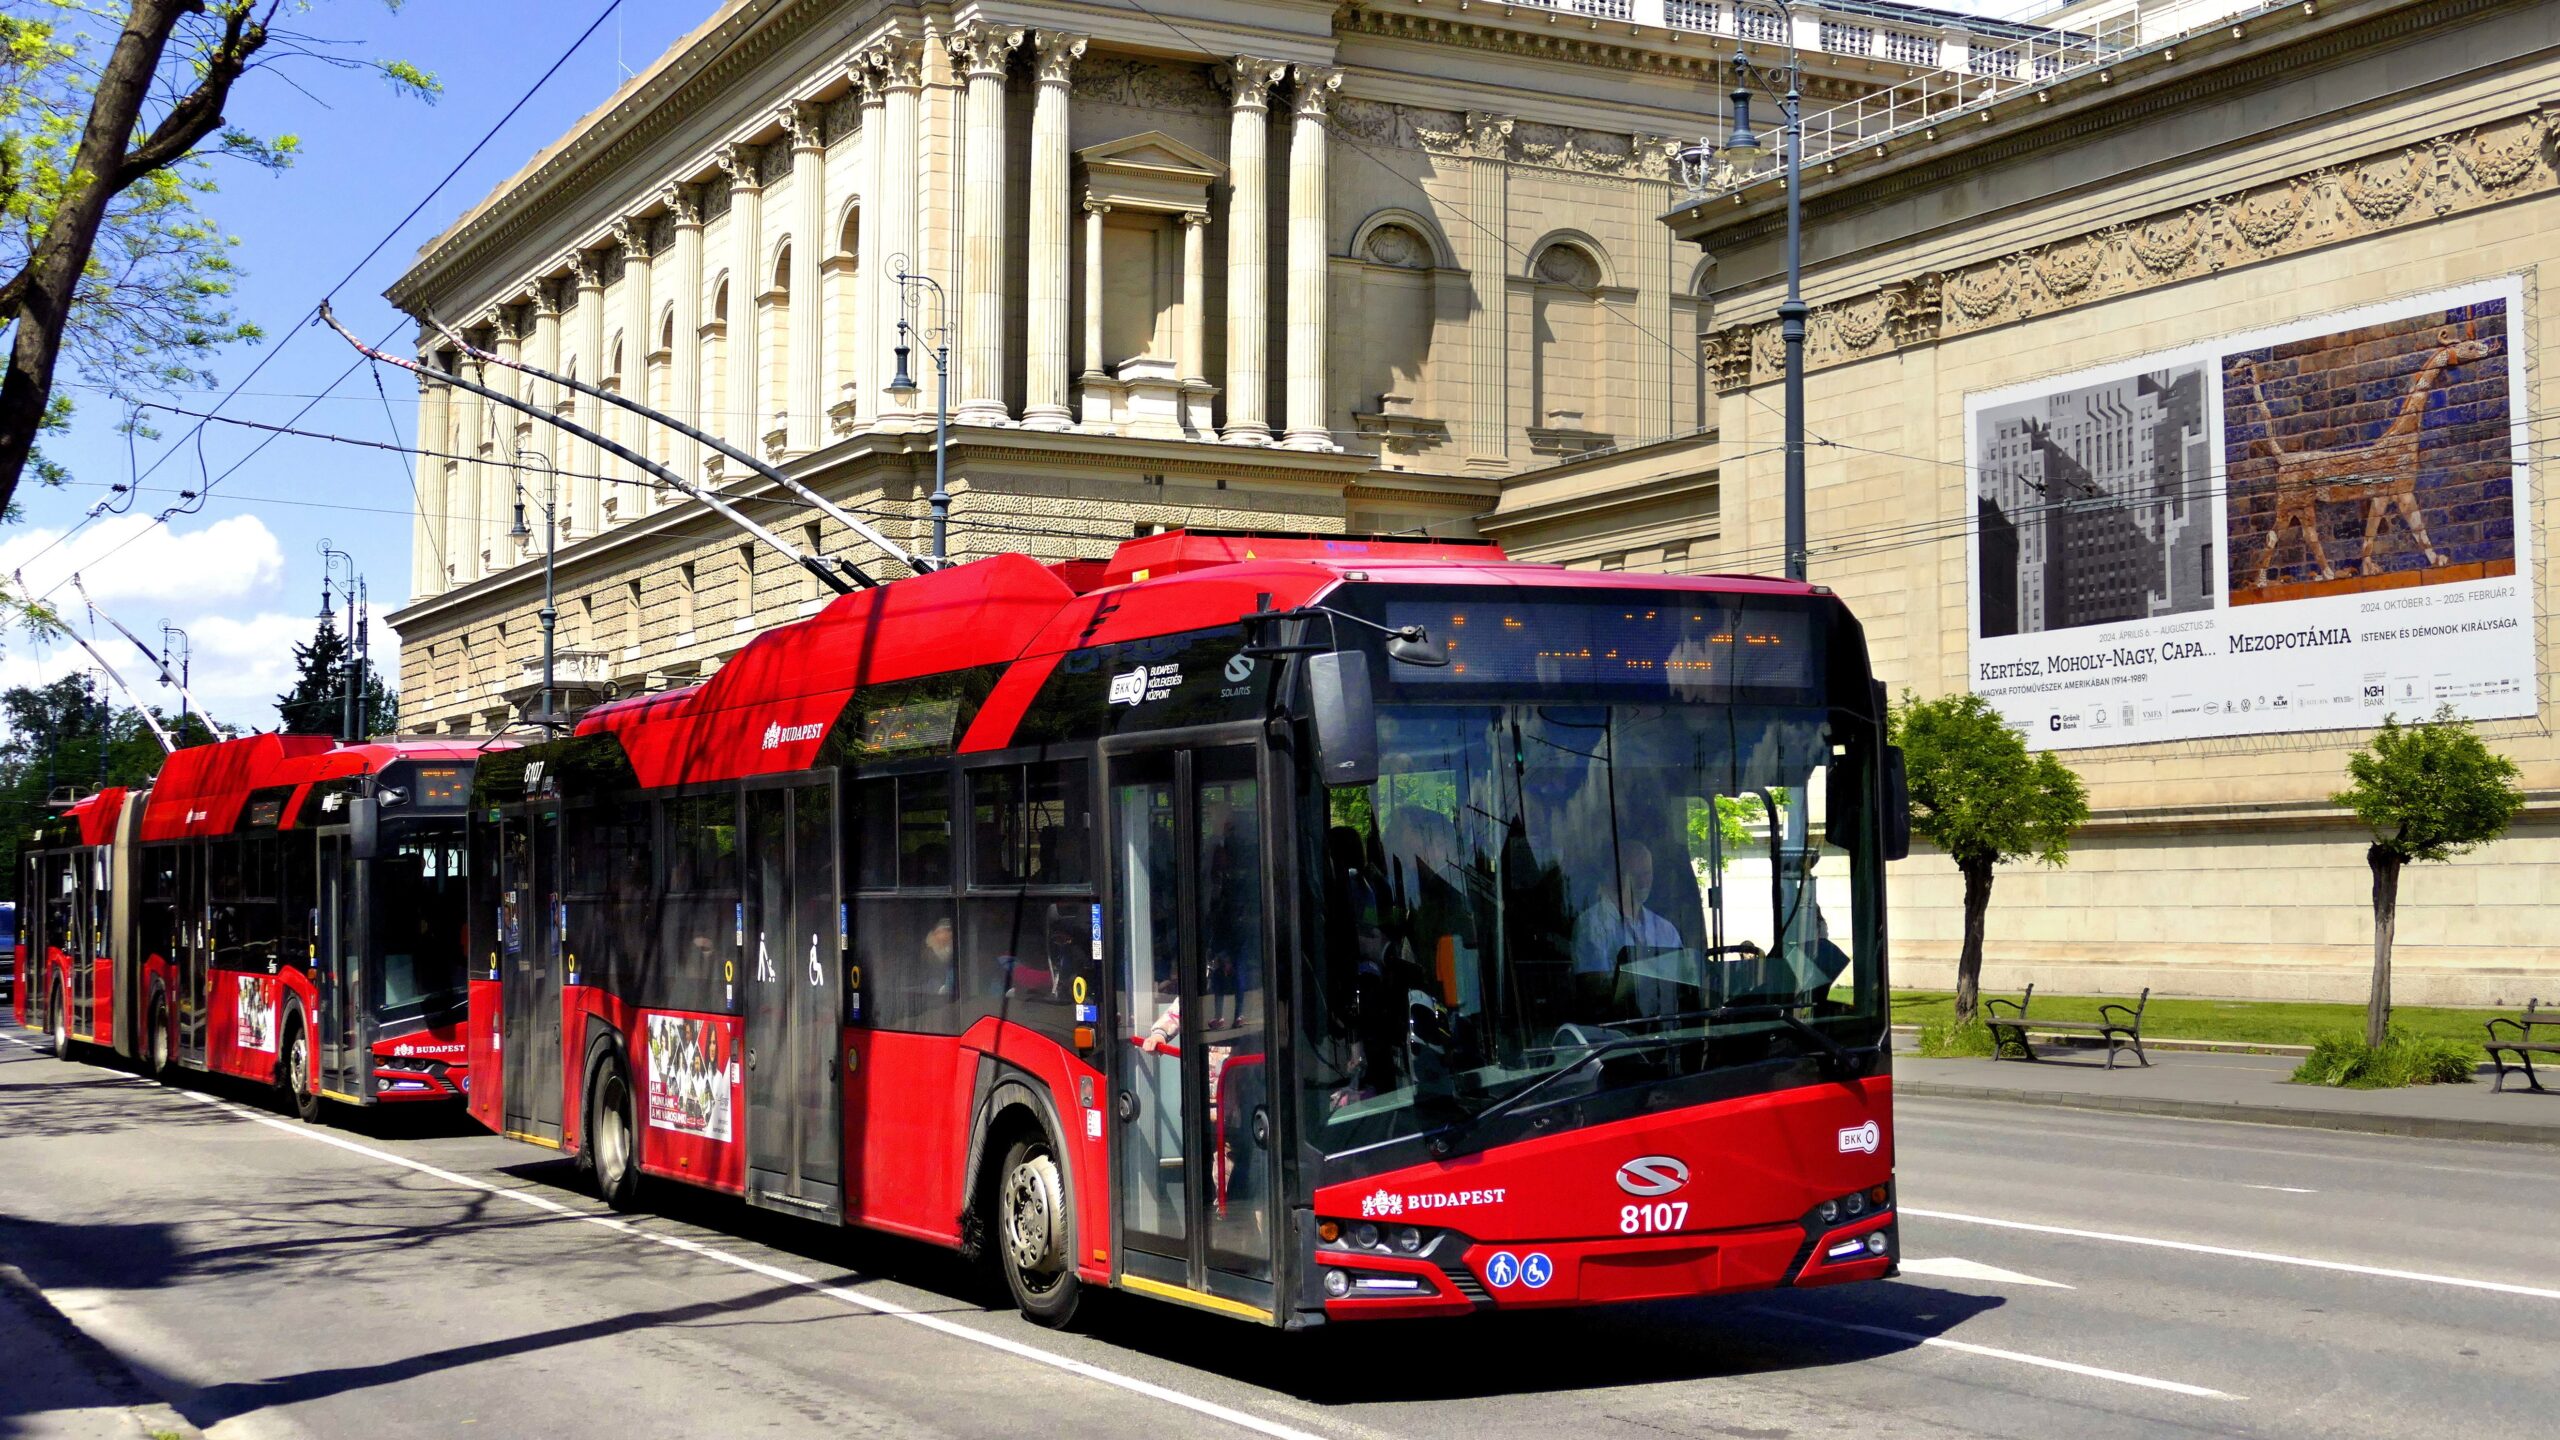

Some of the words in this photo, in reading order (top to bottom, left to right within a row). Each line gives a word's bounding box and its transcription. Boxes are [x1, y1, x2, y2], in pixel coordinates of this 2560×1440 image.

[2384, 595, 2424, 611] OKTÓBER
[2469, 586, 2507, 601] FEBRUÁR
[2160, 620, 2204, 635] AUGUSZTUS
[2361, 630, 2397, 642] ISTENEK
[2400, 627, 2410, 639] ÉS
[2412, 623, 2459, 638] DÉMONOK
[2461, 617, 2518, 633] KIRÁLYSÁGA
[2229, 625, 2352, 654] MEZOPOTÁMIA
[1150, 663, 1179, 677] BUDAPESTI
[1220, 686, 1251, 698] SOLARIS
[1980, 687, 2007, 697] MAGYAR
[2064, 676, 2110, 690] AMERIKÁBAN
[2364, 685, 2384, 698] MBH
[2364, 698, 2384, 707] BANK
[780, 723, 824, 742] BUDAPEST
[524, 761, 545, 783] 8107
[416, 1045, 466, 1053] BUDAPEST
[1845, 1134, 1862, 1145] BKK
[1408, 1189, 1505, 1209] BUDAPEST
[1620, 1202, 1688, 1234] 8107
